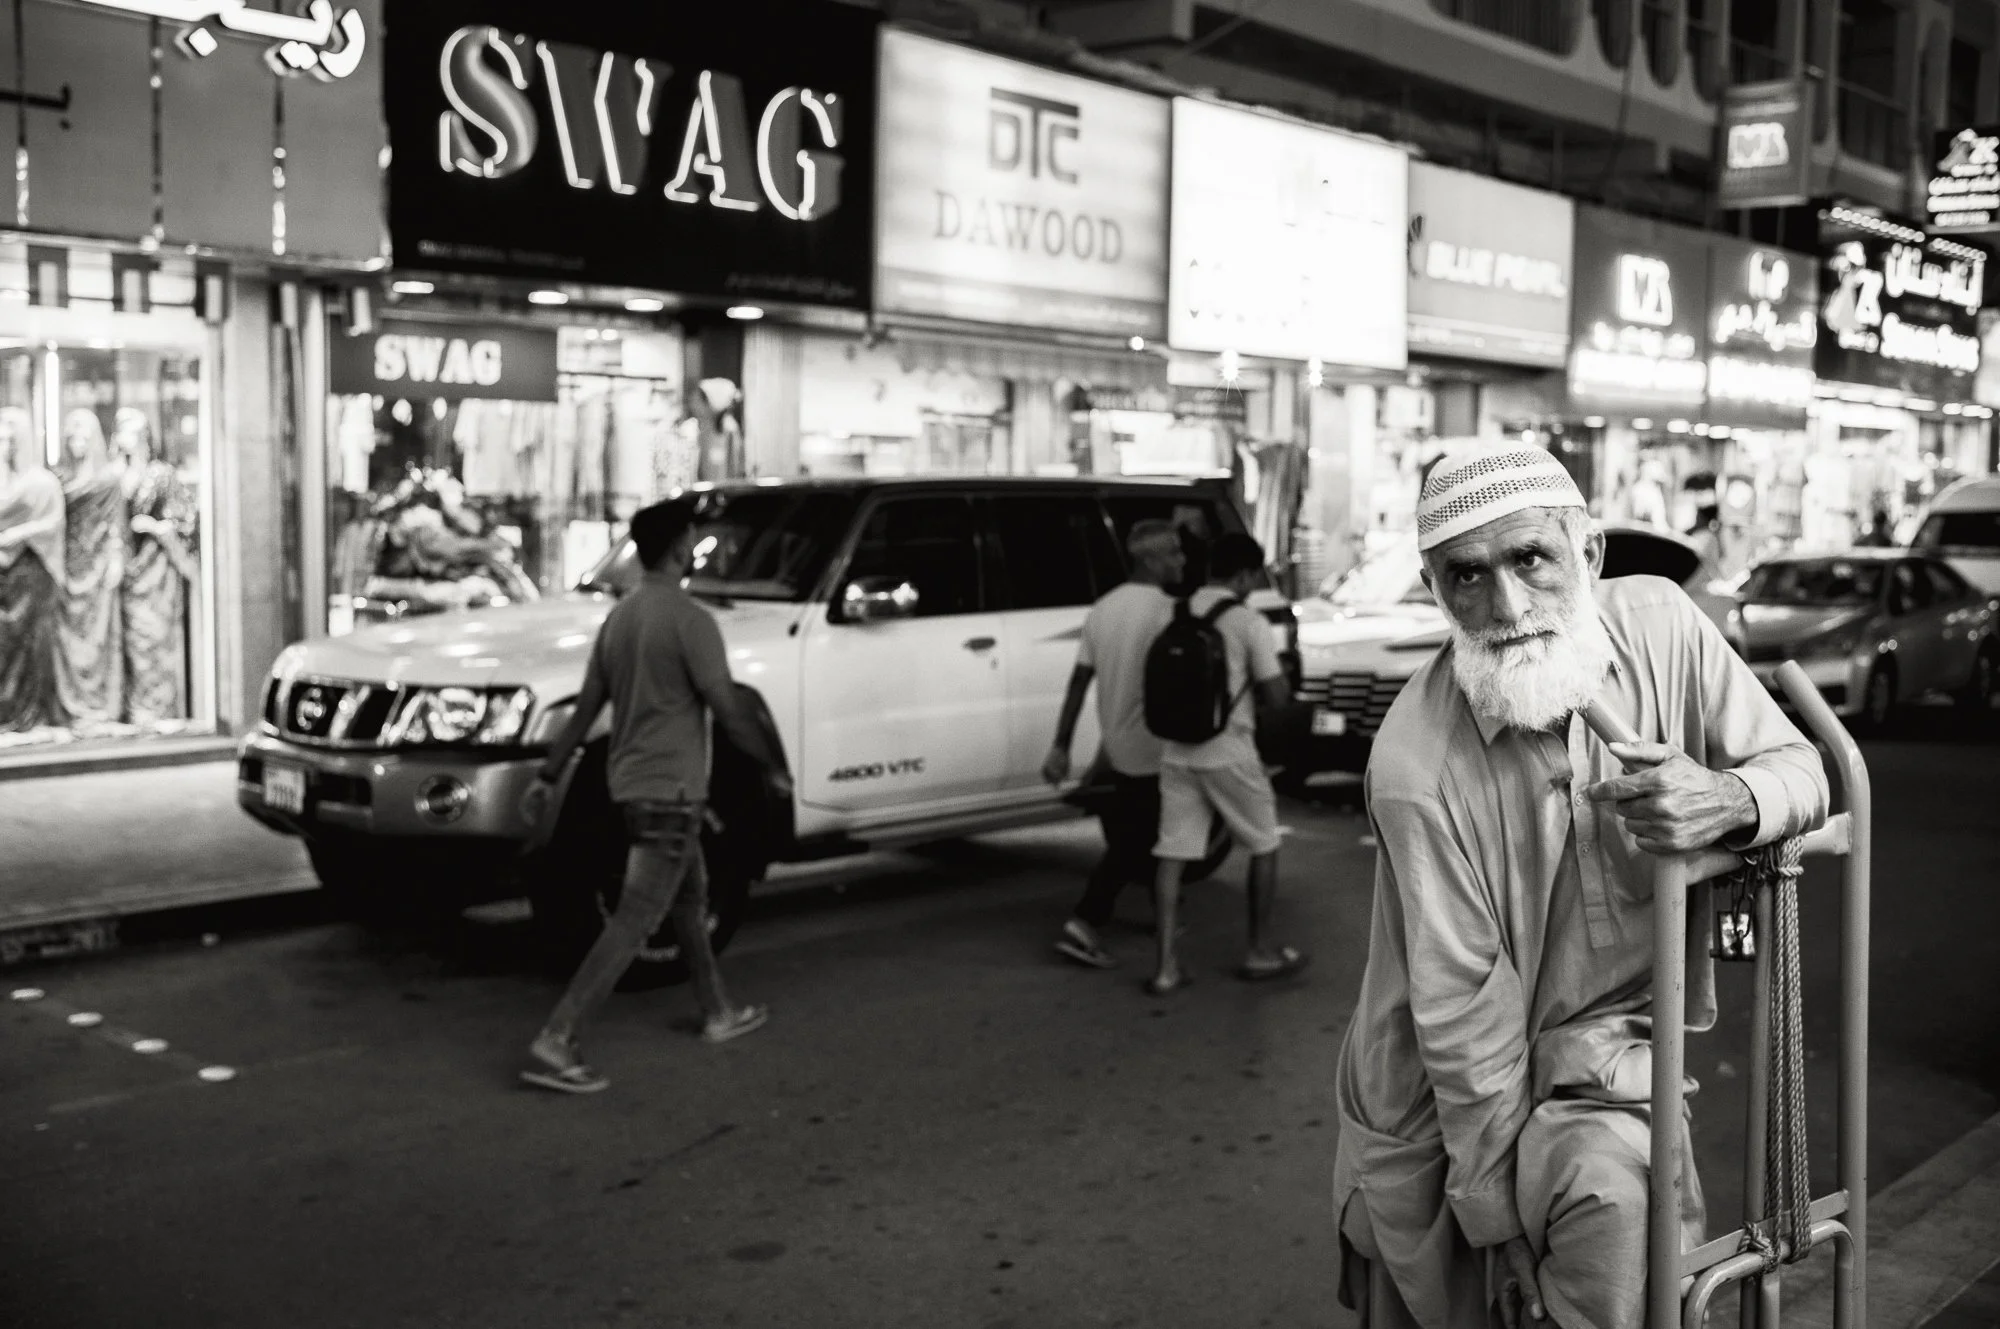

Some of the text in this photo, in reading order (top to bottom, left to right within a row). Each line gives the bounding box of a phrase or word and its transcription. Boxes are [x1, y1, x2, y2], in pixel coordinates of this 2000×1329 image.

[438, 25, 844, 221] SWAG
[989, 87, 1081, 185] DTC
[933, 190, 1124, 264] DAWOOD
[373, 334, 502, 385] SWAG
[827, 756, 925, 781] 4800 VTC
